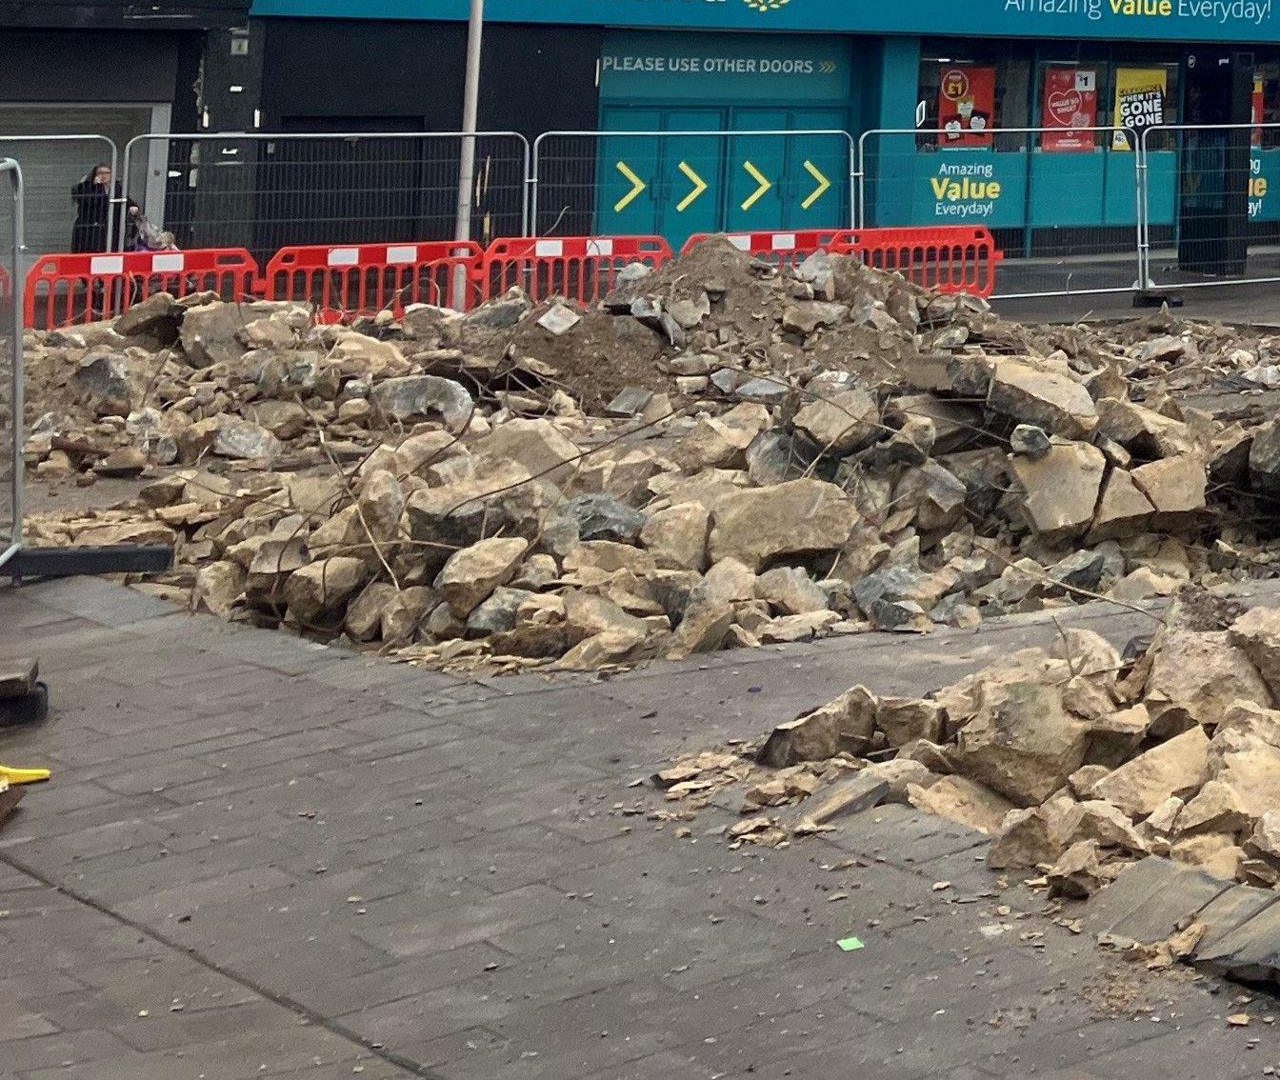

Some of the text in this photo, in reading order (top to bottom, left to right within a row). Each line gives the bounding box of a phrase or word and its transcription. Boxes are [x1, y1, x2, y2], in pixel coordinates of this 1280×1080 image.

[602, 56, 814, 73] PLEASE USE OTHER DOORS
[1120, 98, 1162, 117] GONE
[1125, 112, 1163, 128] GONE
[939, 163, 993, 178] Amazing
[930, 177, 1001, 200] Value
[935, 201, 993, 218] Everyday!
